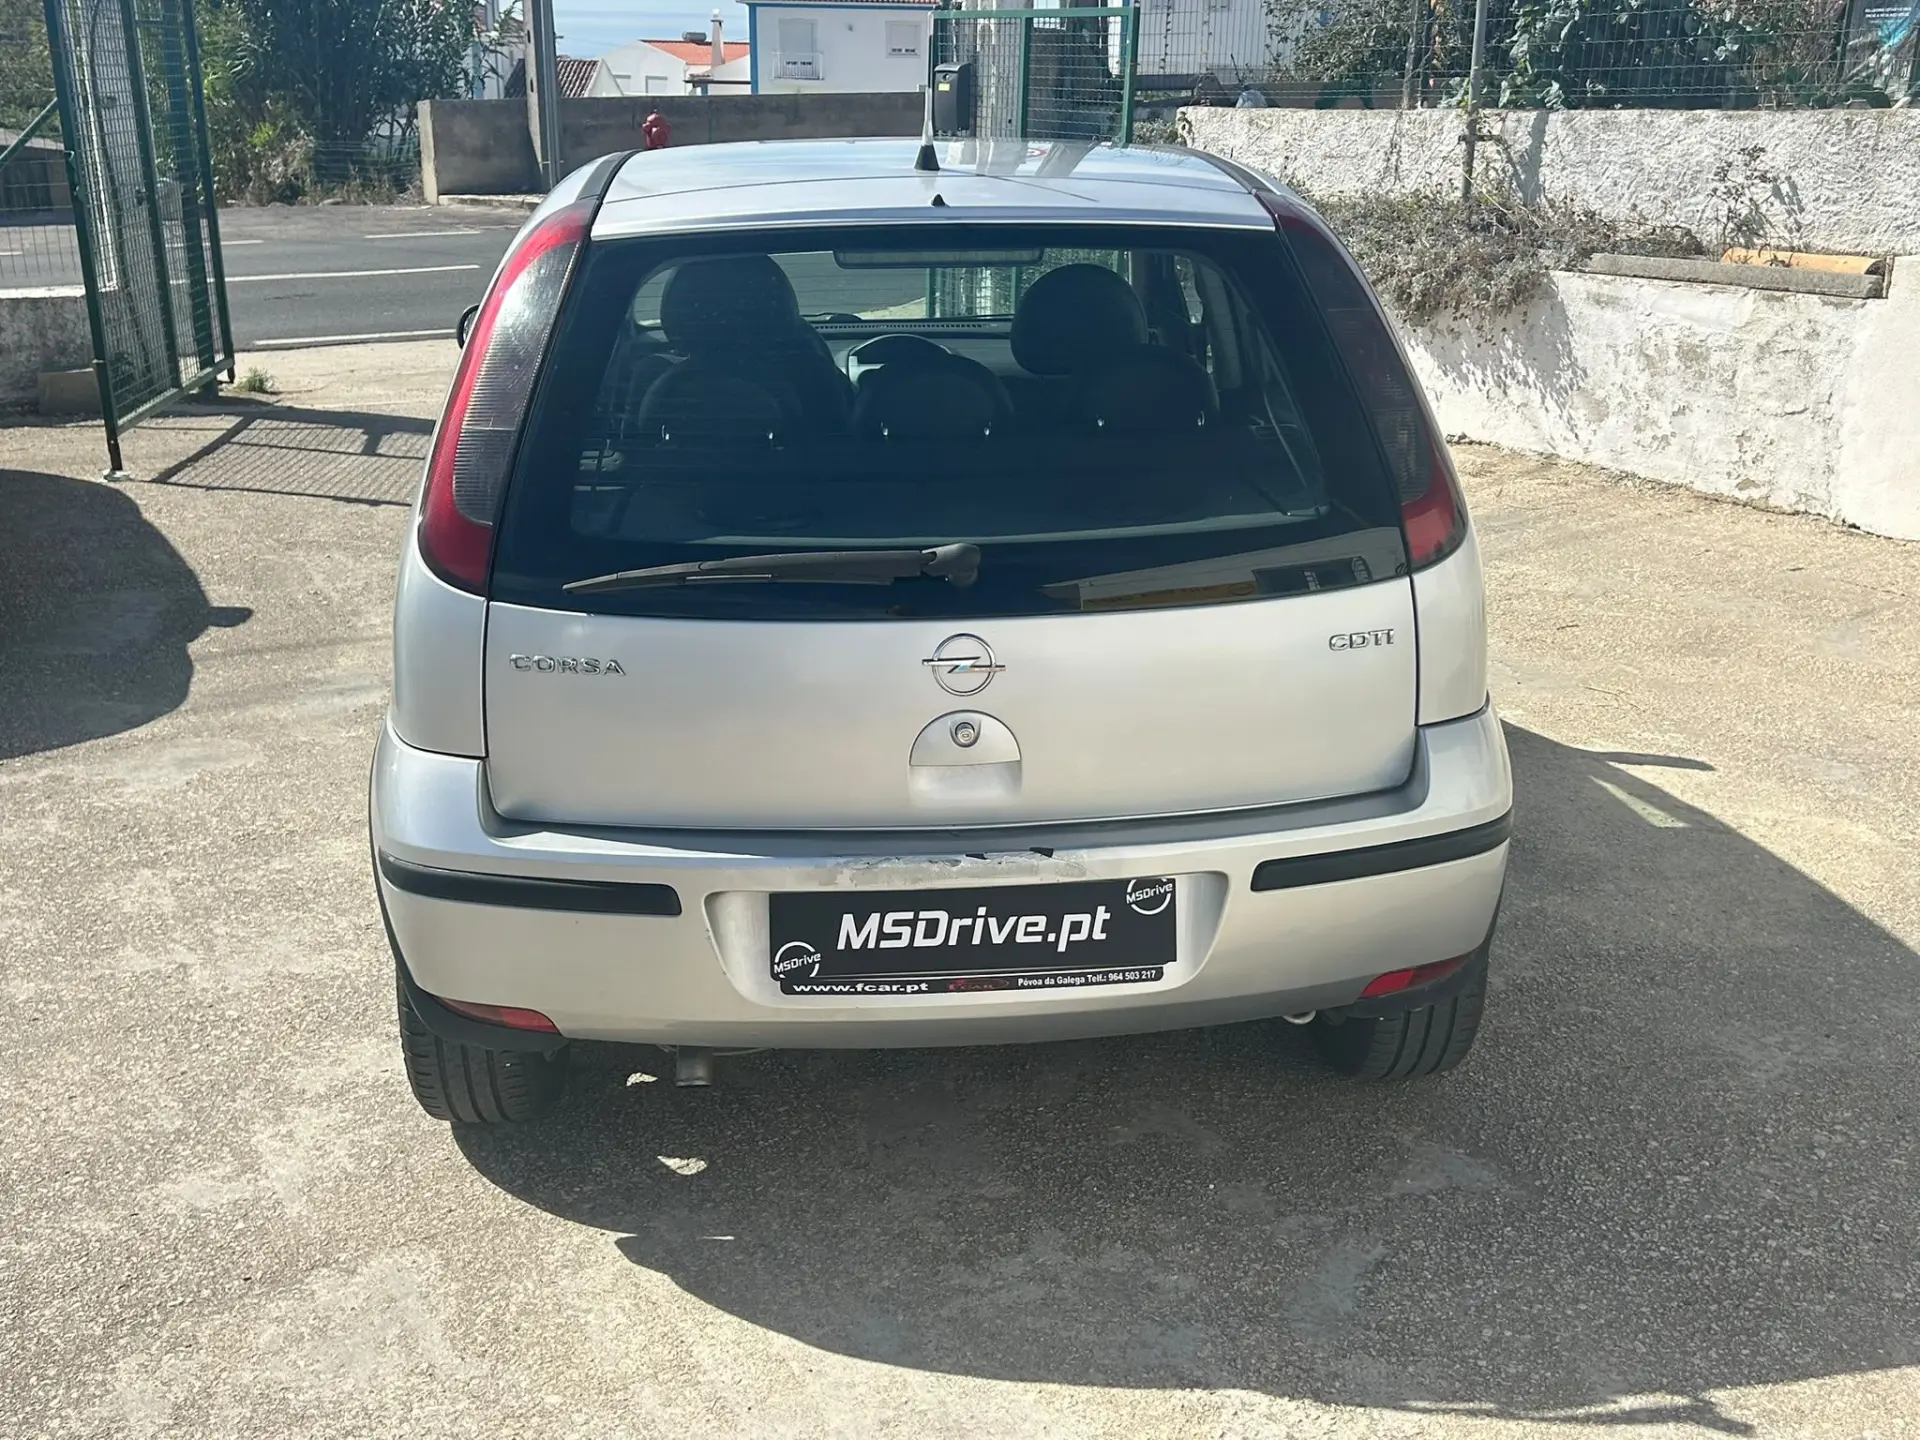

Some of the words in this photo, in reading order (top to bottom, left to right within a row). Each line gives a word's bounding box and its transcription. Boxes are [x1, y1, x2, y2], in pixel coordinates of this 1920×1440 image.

[1328, 628, 1394, 652] CDTI
[509, 653, 627, 676] CORSA
[1126, 883, 1173, 904] MSDrive
[836, 906, 1111, 952] MSDrive.pt
[773, 953, 821, 974] MSDrive
[793, 982, 929, 993] www.fcar.pt
[1017, 977, 1043, 987] Póvoa
[1044, 977, 1055, 985] da
[1057, 974, 1085, 986] Galega
[1108, 971, 1123, 982] 964
[1125, 971, 1140, 981] 503
[1141, 970, 1156, 980] 217
